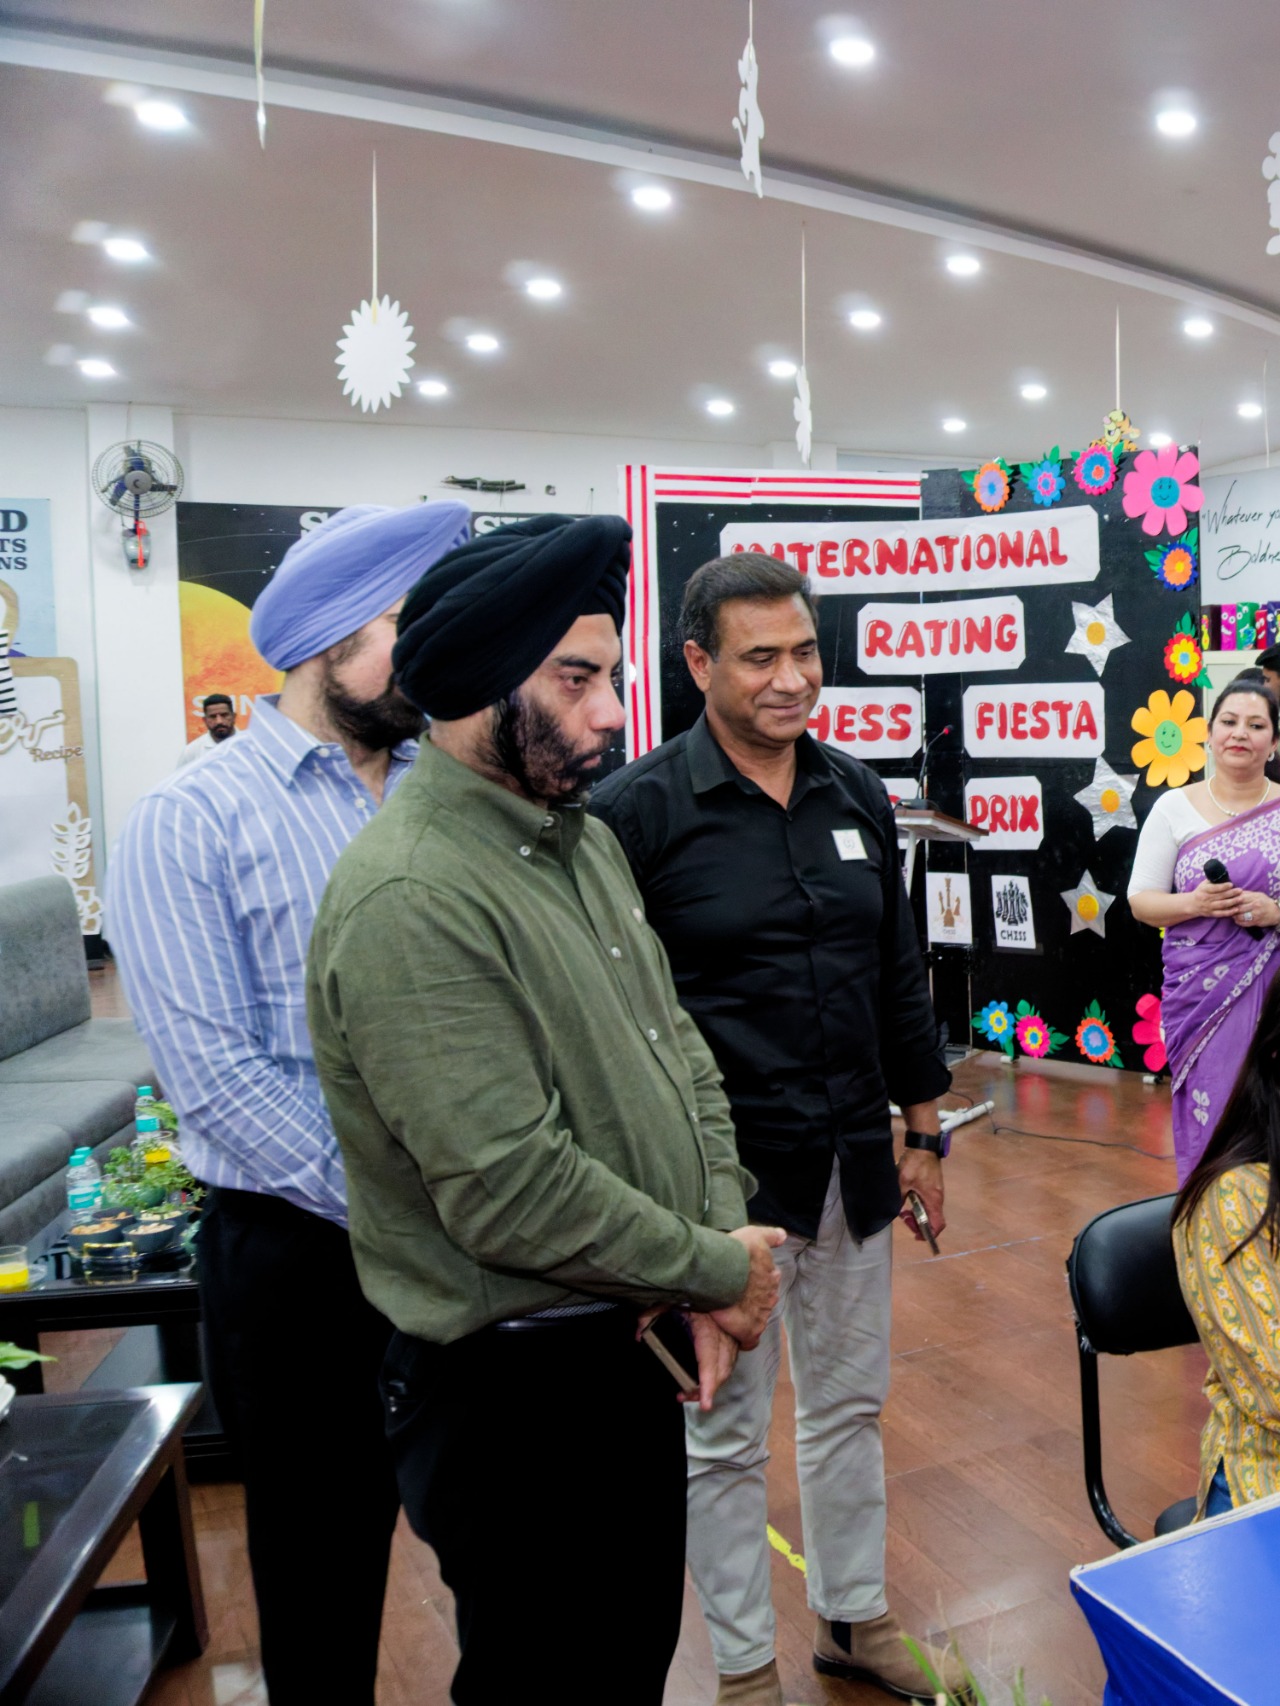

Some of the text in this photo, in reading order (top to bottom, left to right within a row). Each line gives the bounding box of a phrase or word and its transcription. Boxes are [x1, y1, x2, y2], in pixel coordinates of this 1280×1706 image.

[731, 526, 1069, 578] TERNATIONAL
[864, 613, 1018, 659] RATING
[806, 700, 1099, 743] HESS FIESTA
[967, 794, 1040, 833] PRIX
